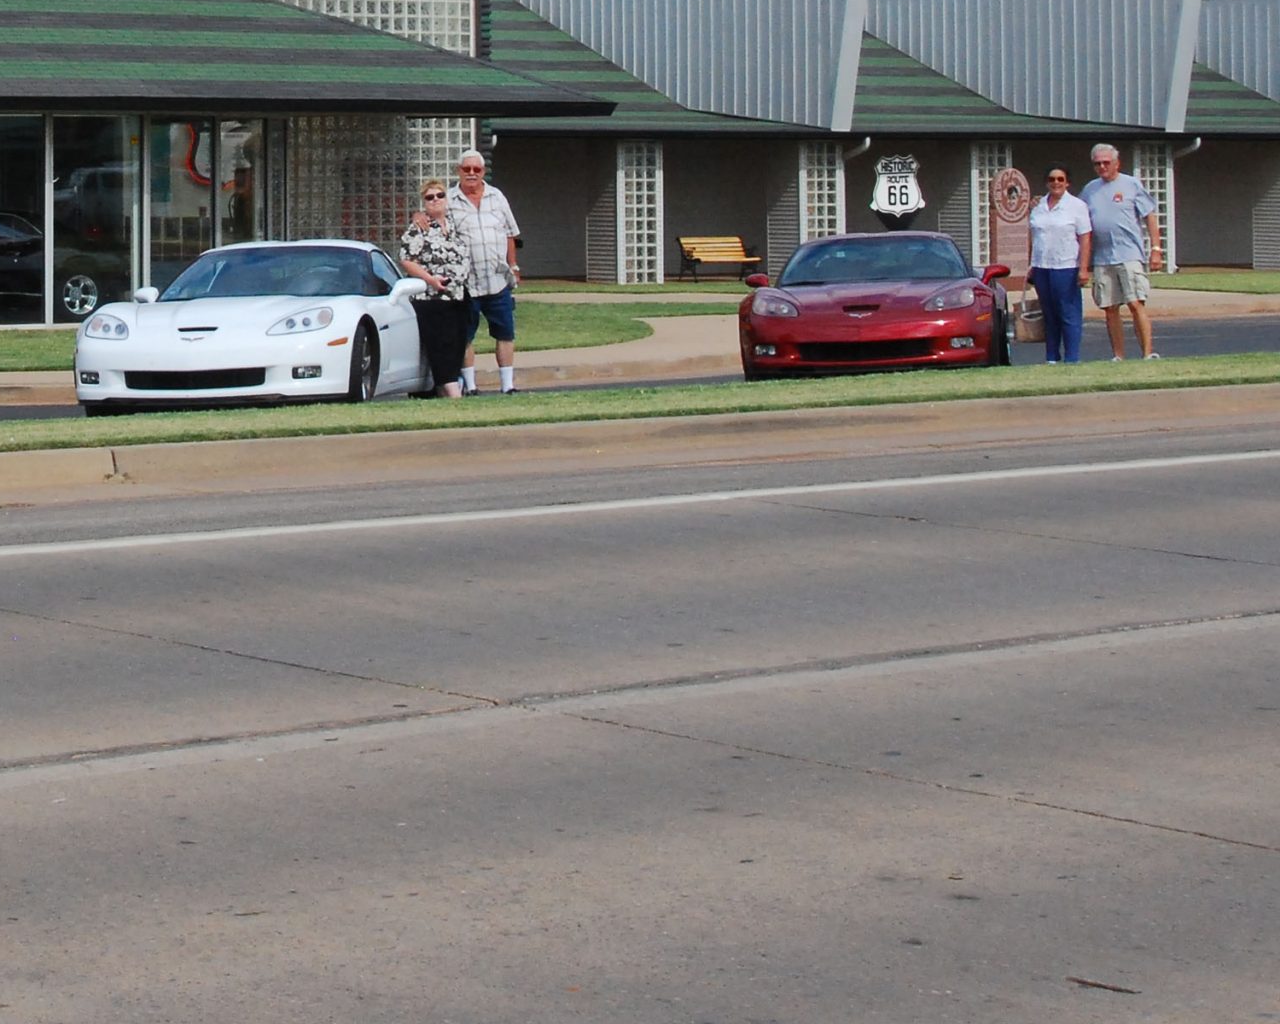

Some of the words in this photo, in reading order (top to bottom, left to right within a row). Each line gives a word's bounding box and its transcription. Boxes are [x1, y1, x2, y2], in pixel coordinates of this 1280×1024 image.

[880, 160, 915, 173] HISTORIC
[886, 175, 910, 184] ROUTE
[888, 185, 909, 206] 66
